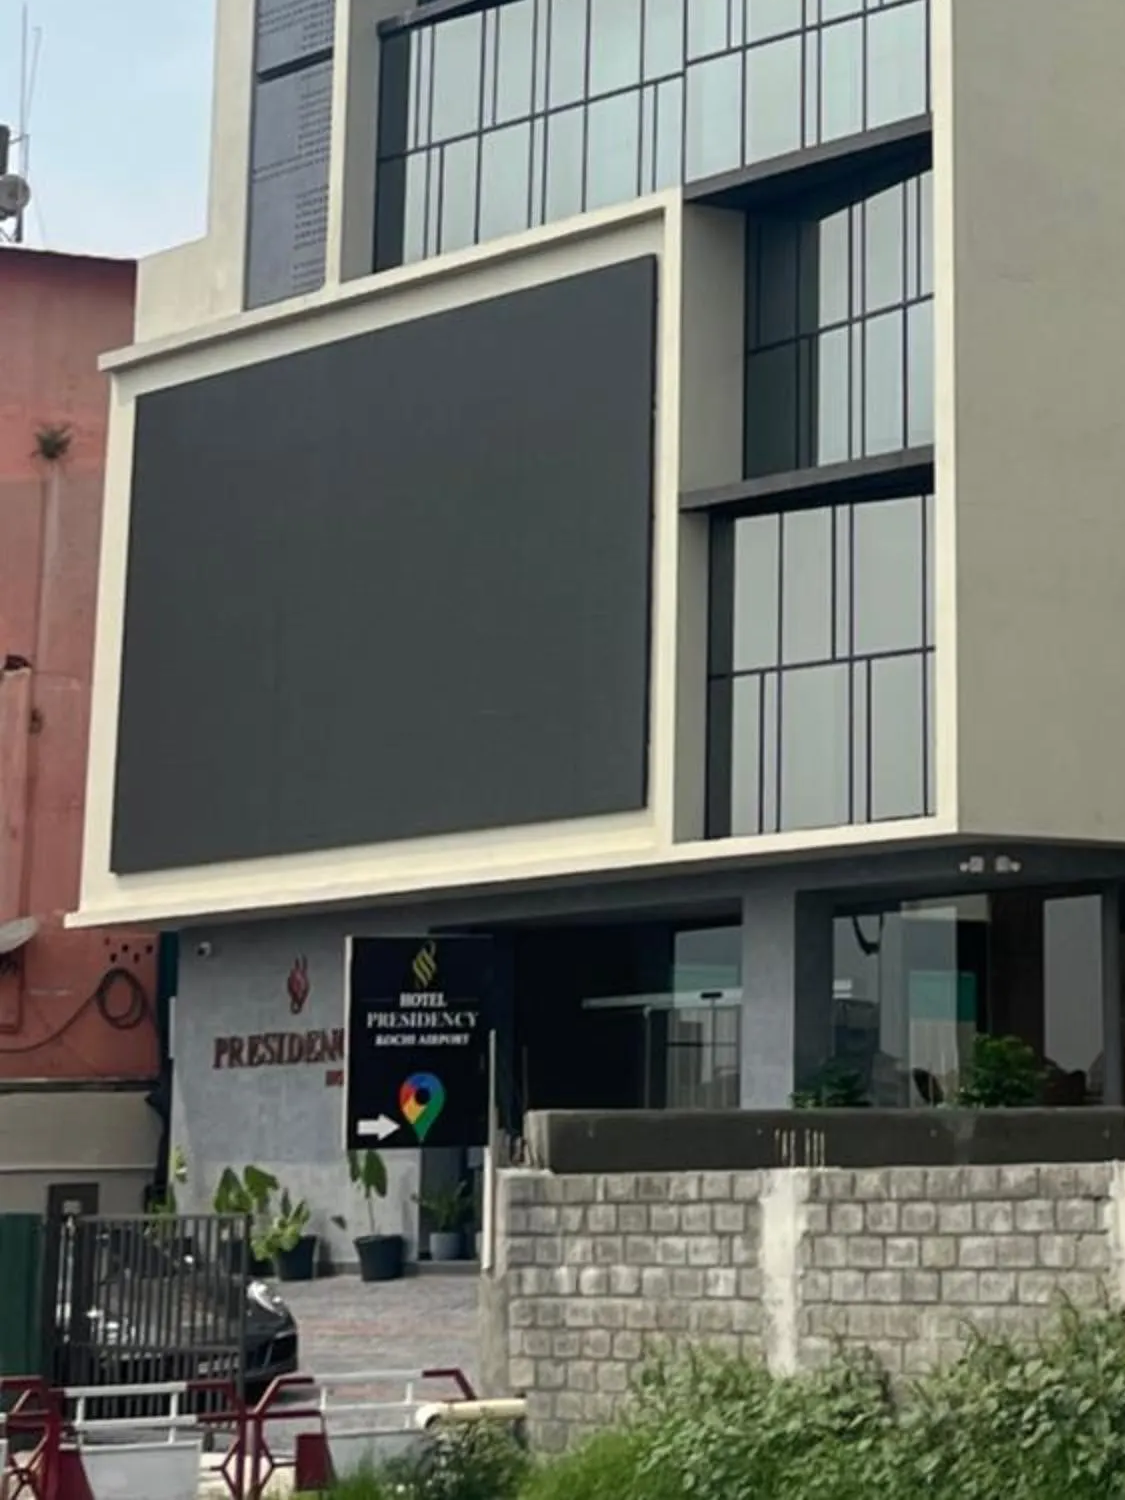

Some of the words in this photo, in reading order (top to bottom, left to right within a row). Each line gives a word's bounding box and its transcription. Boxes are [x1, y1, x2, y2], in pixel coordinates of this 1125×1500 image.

[400, 992, 448, 1008] HOTEL
[367, 1011, 479, 1028] PRESIDENCY
[418, 1032, 470, 1045] AIRPORT
